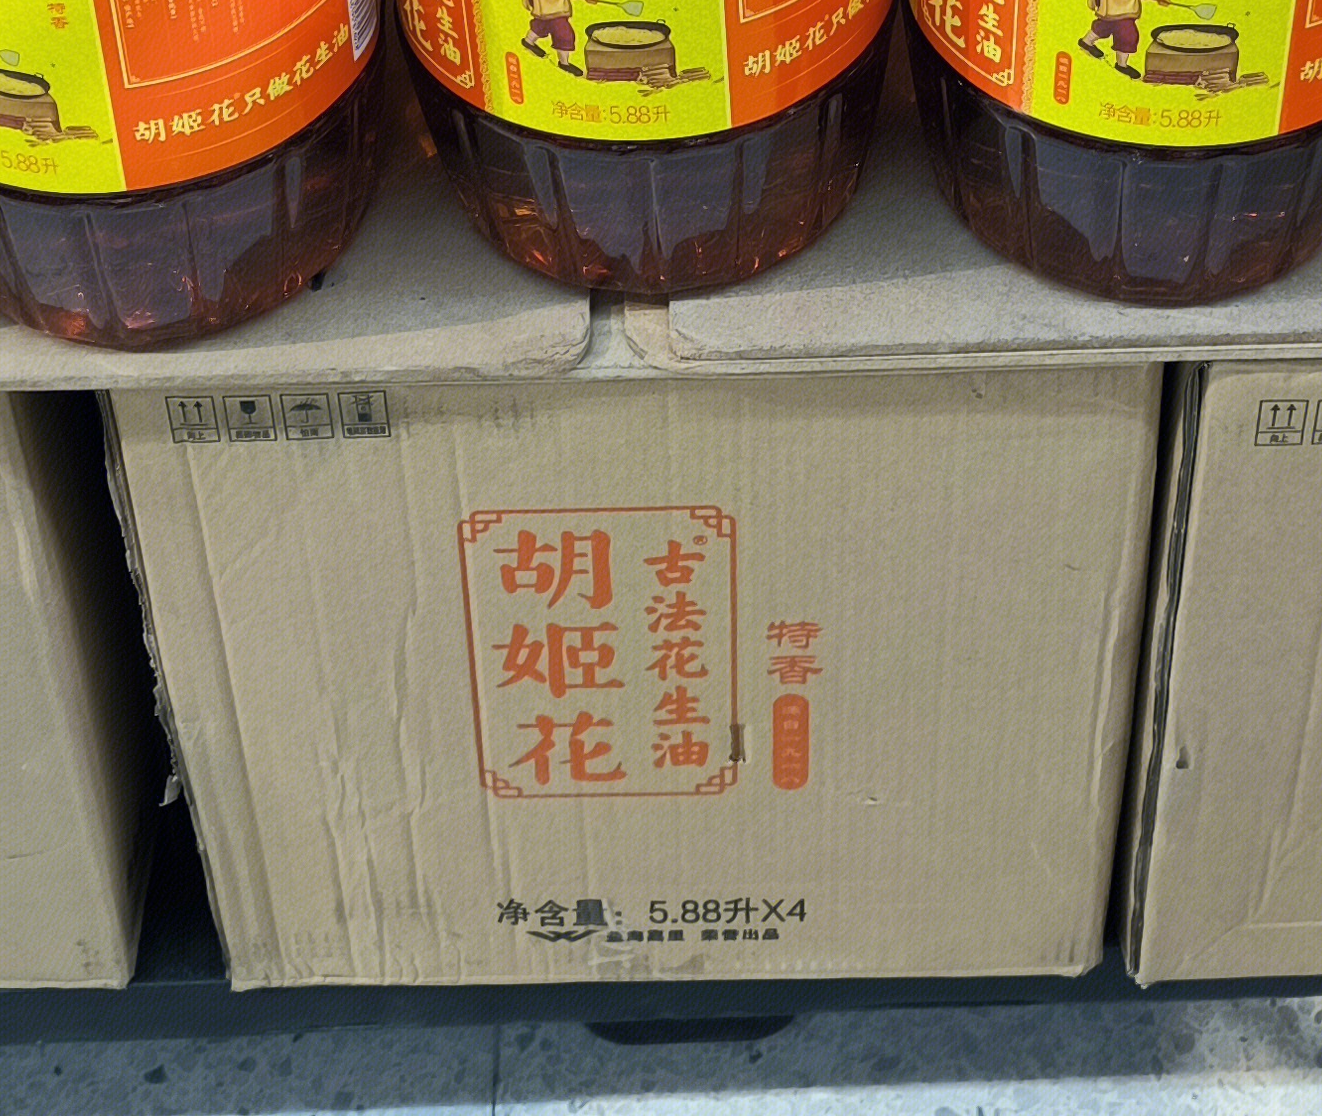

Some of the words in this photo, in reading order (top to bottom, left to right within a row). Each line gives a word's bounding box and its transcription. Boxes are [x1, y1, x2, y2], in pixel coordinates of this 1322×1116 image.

[131, 22, 351, 146] 胡姬花只做花生油
[491, 529, 627, 785] 胡姬花
[642, 539, 712, 770] 古法花生油
[765, 620, 824, 685] 特香
